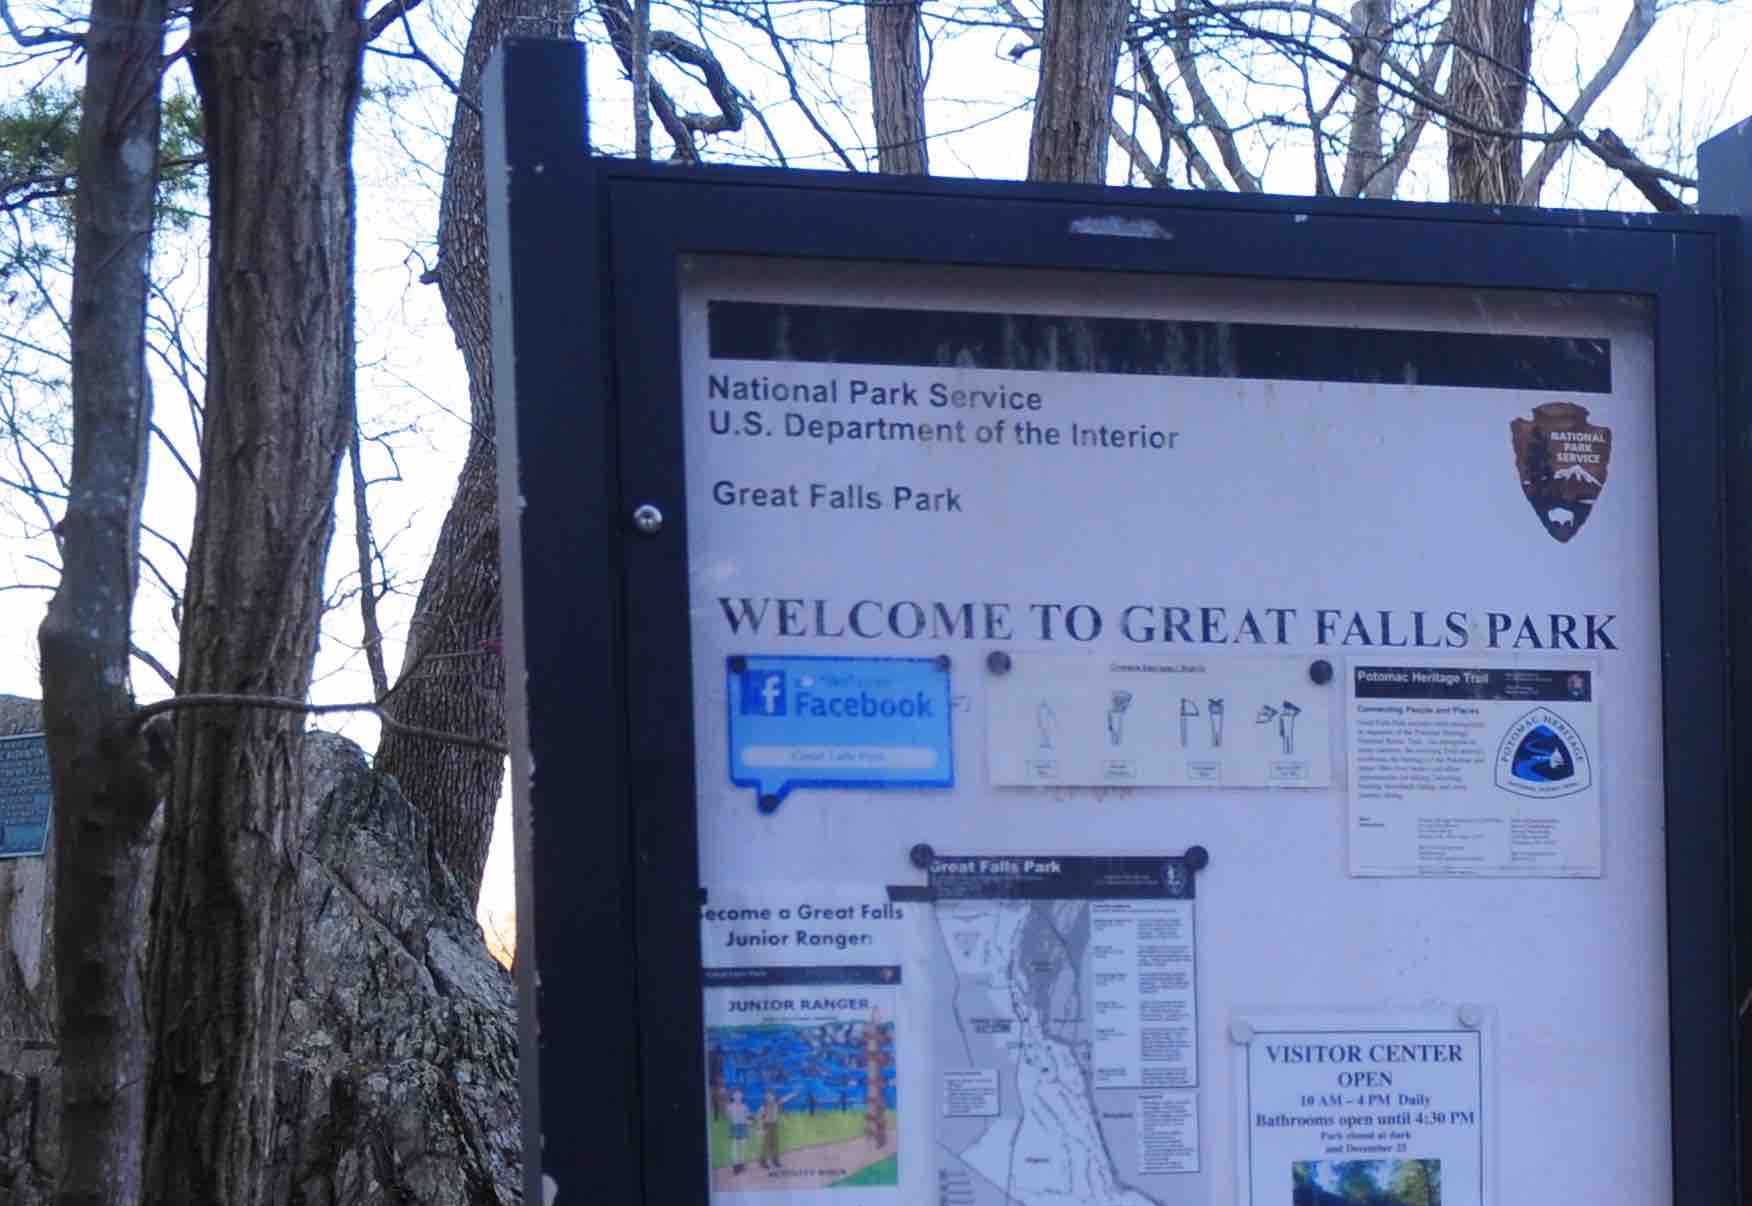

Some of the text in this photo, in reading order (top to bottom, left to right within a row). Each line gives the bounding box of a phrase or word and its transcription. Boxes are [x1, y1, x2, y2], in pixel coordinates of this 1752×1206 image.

[708, 375, 1042, 411] National Park Service
[709, 411, 1179, 450] U.S. Department of the Interior
[1551, 432, 1606, 442] NATIONAL
[1564, 443, 1592, 453] PARK
[1556, 453, 1601, 463] SERVICE
[713, 481, 962, 513] Great Falls Park
[719, 596, 1618, 651] WELCOME TO GREAT FALLS PARK
[1357, 670, 1489, 685] Potomac Heritage Trail
[795, 690, 934, 718] Facebook
[930, 860, 1062, 873] Great Falls Park
[778, 908, 791, 920] a
[797, 904, 854, 920] Great
[861, 904, 903, 920] Falls
[725, 929, 789, 947] Junior
[728, 998, 869, 1013] JUNIOR RANGER
[1265, 1043, 1463, 1064] VISITOR CENTER
[1337, 1071, 1393, 1088] OPEN
[1300, 1094, 1315, 1107] 10
[1317, 1094, 1343, 1107] AM
[1358, 1094, 1367, 1106] 4
[1369, 1094, 1391, 1106] PM
[1399, 1093, 1431, 1106] Daily
[1256, 1111, 1475, 1129] Bathrooms open until 4:30 PM
